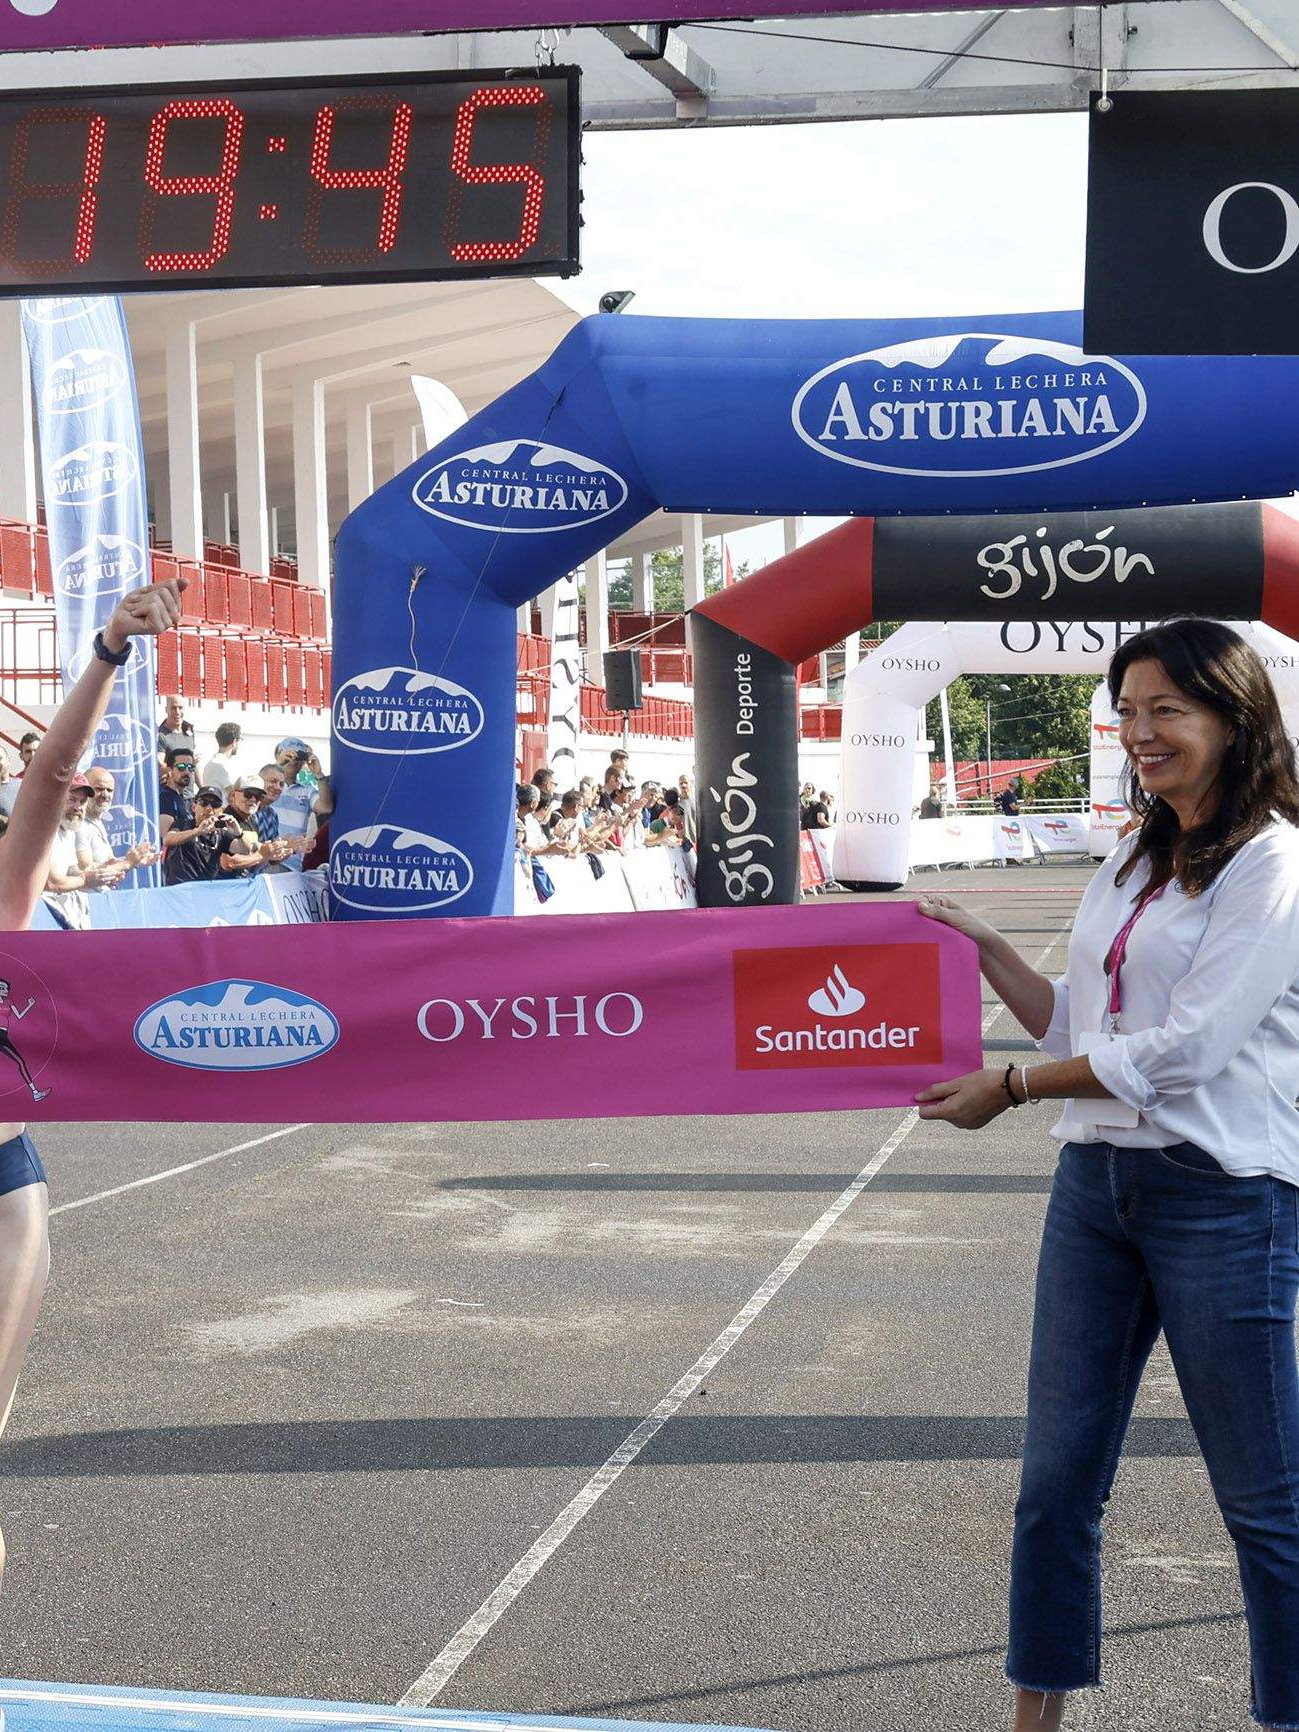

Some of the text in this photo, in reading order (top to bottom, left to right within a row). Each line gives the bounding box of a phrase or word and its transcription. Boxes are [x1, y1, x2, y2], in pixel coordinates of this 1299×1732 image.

[874, 371, 1108, 393] CENTRAL LECHERA
[818, 381, 1119, 441] ASTURIANA
[424, 470, 610, 511] ASTURIANA
[461, 468, 607, 486] CENTRAL LECHERA
[977, 525, 1155, 600] gijón
[882, 658, 940, 672] OYSHO
[353, 695, 468, 709] CENTRAL LECHERA
[734, 652, 758, 735] Deporte
[336, 697, 472, 734] ASTURIANA
[851, 733, 905, 748] OYSHO
[709, 752, 774, 901] gijón
[846, 811, 900, 825] OYSHO
[332, 853, 461, 891] ASTURIANA
[344, 852, 456, 866] CENTRAL LECHERA
[151, 1015, 325, 1048] ASTURIANA
[181, 1011, 316, 1022] CENTRAL LECHERA
[416, 991, 644, 1042] OYSHO
[755, 1021, 920, 1053] Santander
